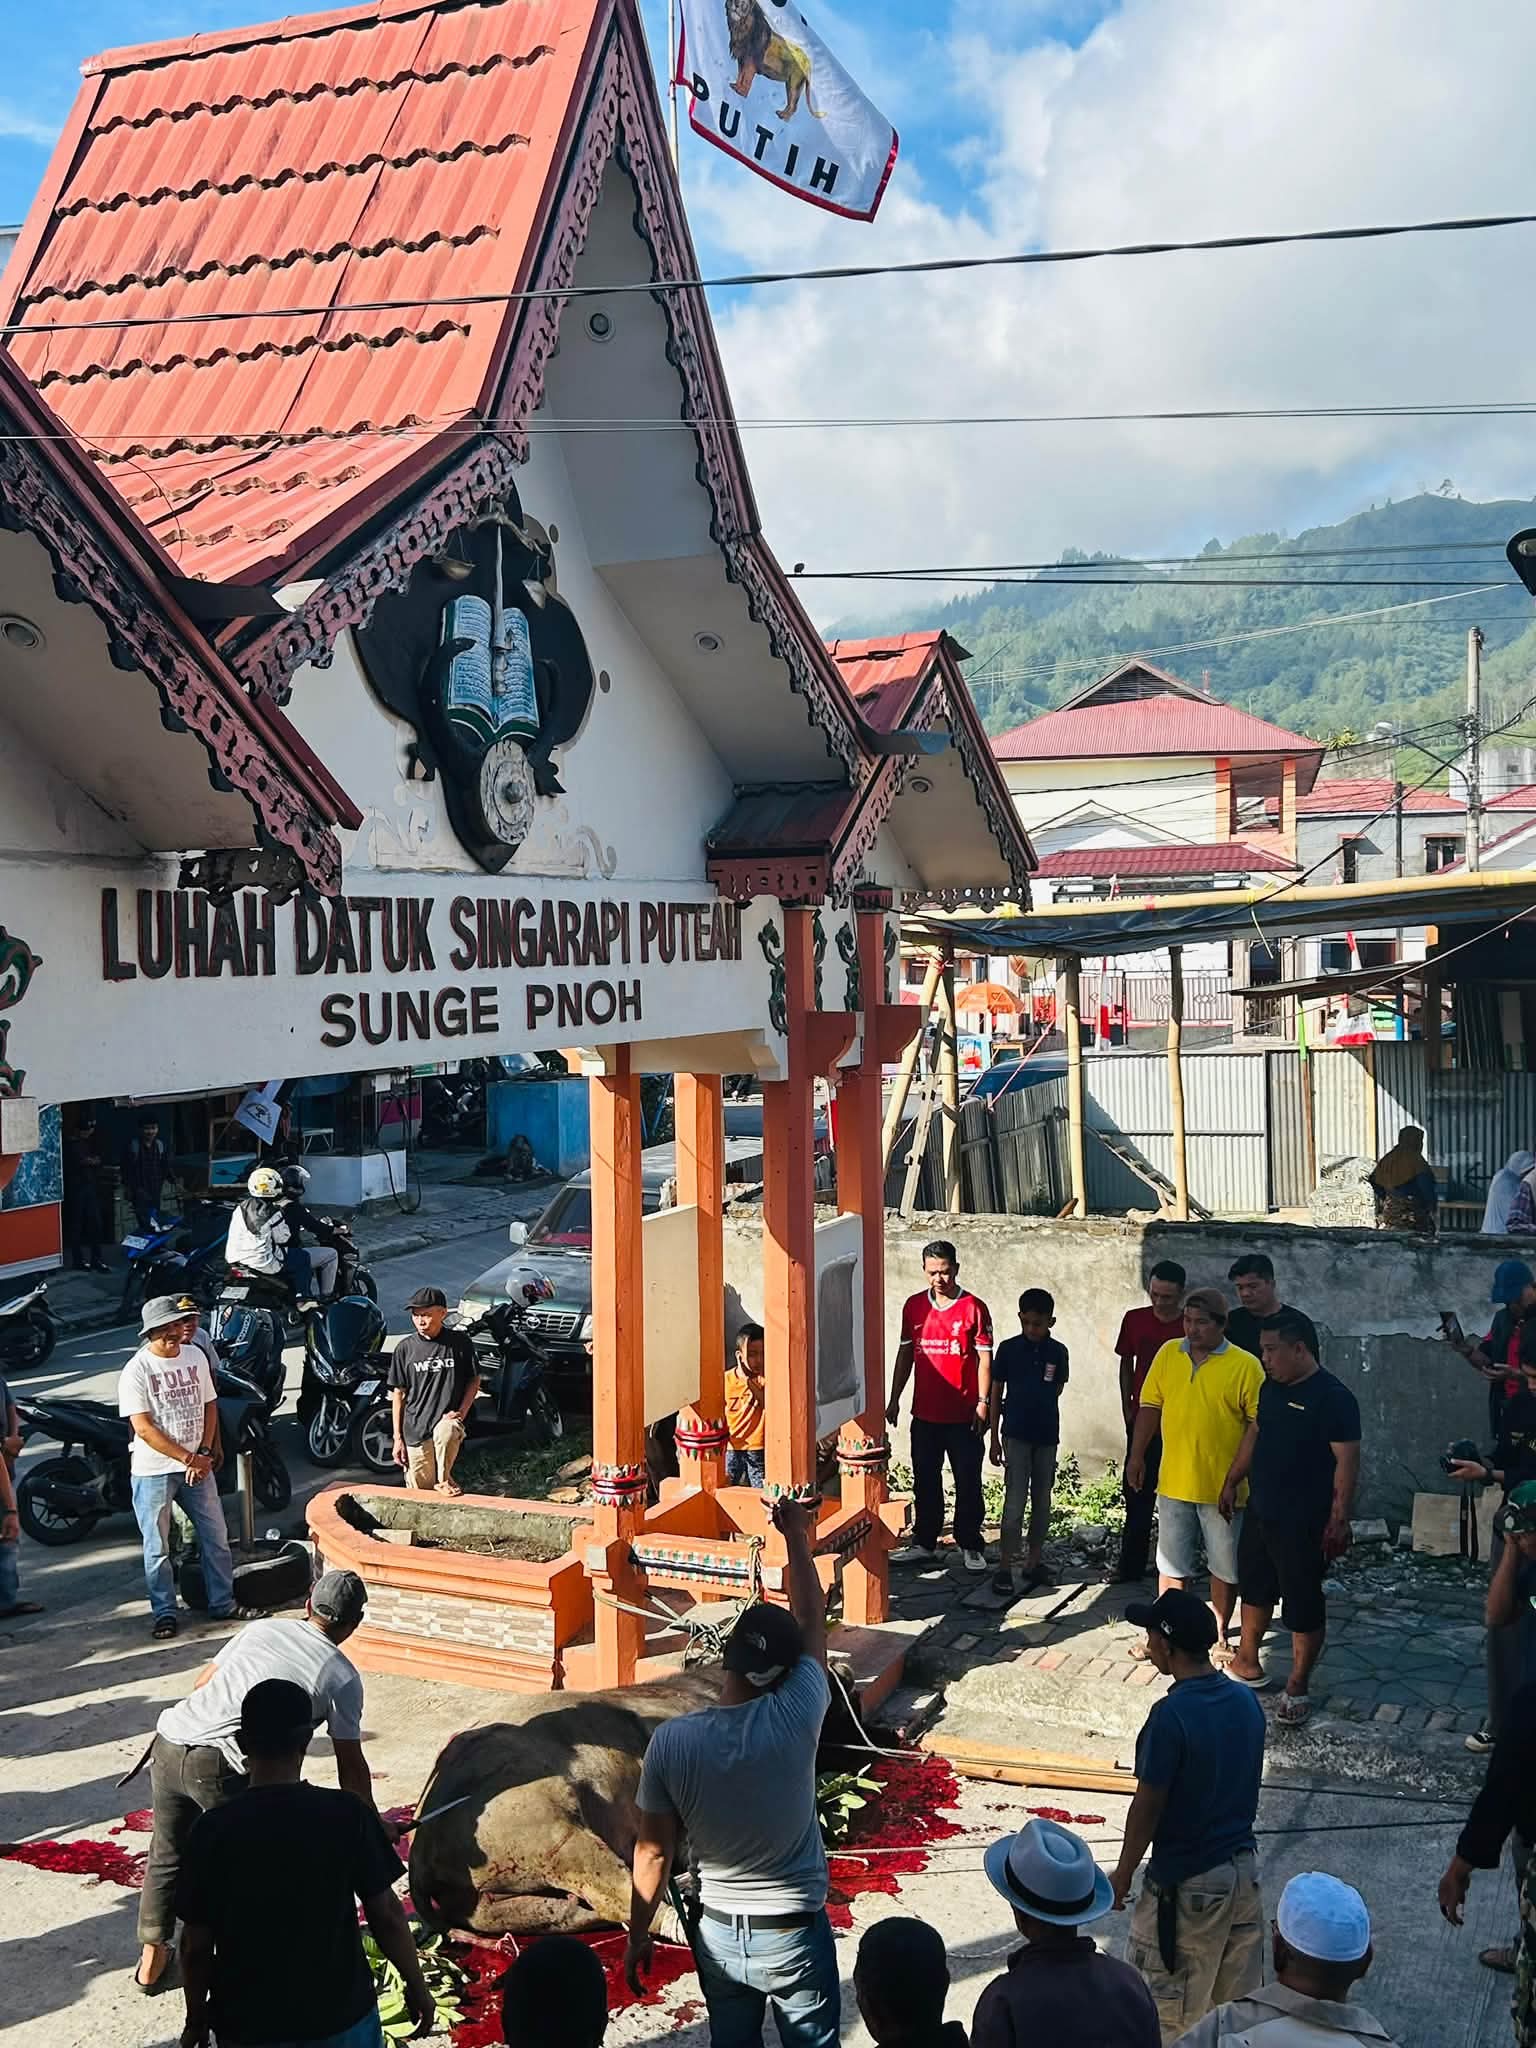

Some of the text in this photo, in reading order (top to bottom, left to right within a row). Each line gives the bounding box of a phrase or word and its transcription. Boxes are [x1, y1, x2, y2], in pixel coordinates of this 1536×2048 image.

[693, 72, 839, 194] PUTIH
[101, 888, 743, 981] LUHAH DATUK SINGARAPI PUTEAH
[321, 979, 643, 1047] SUNGE PNOH
[151, 1365, 200, 1392] FOLK
